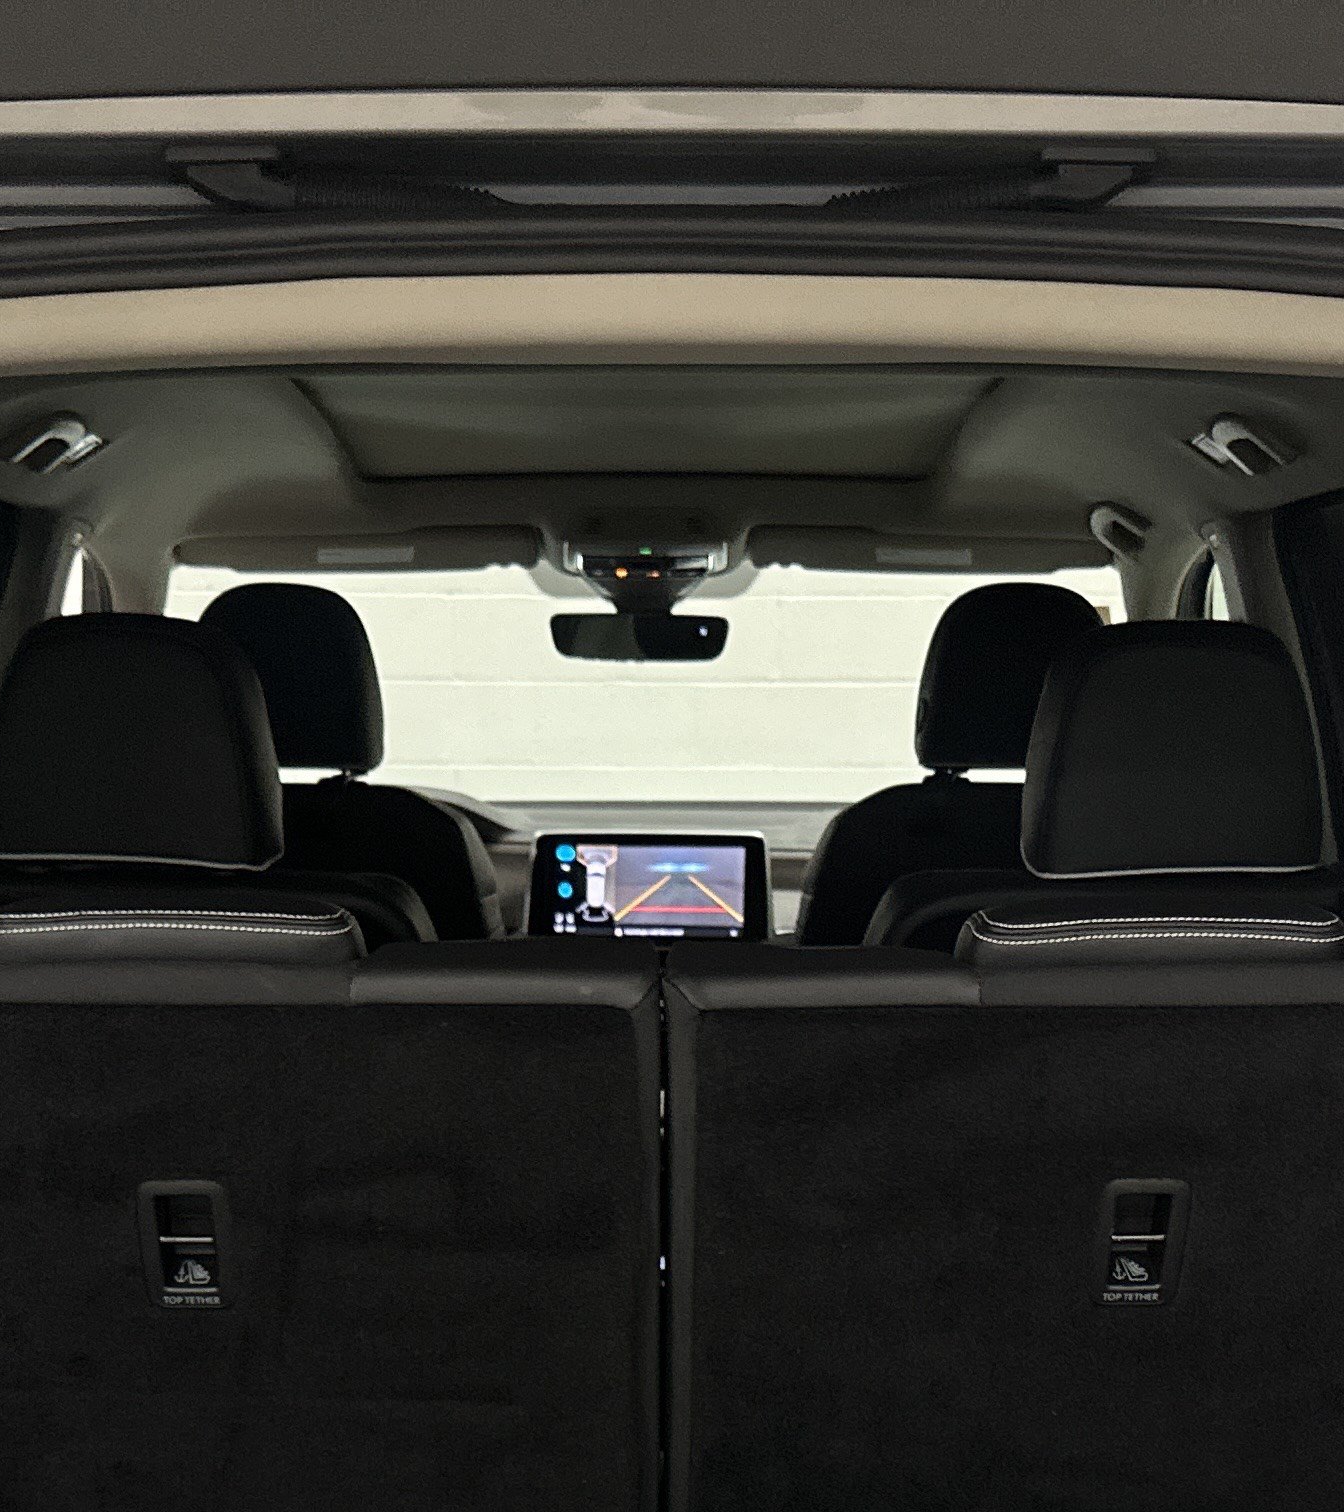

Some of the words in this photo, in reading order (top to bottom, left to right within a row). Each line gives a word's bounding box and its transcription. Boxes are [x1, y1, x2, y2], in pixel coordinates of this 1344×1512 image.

[163, 1295, 183, 1304] TOP
[185, 1295, 220, 1304] TETHER
[1103, 1292, 1122, 1301] TOP
[1124, 1292, 1159, 1301] TETHER
